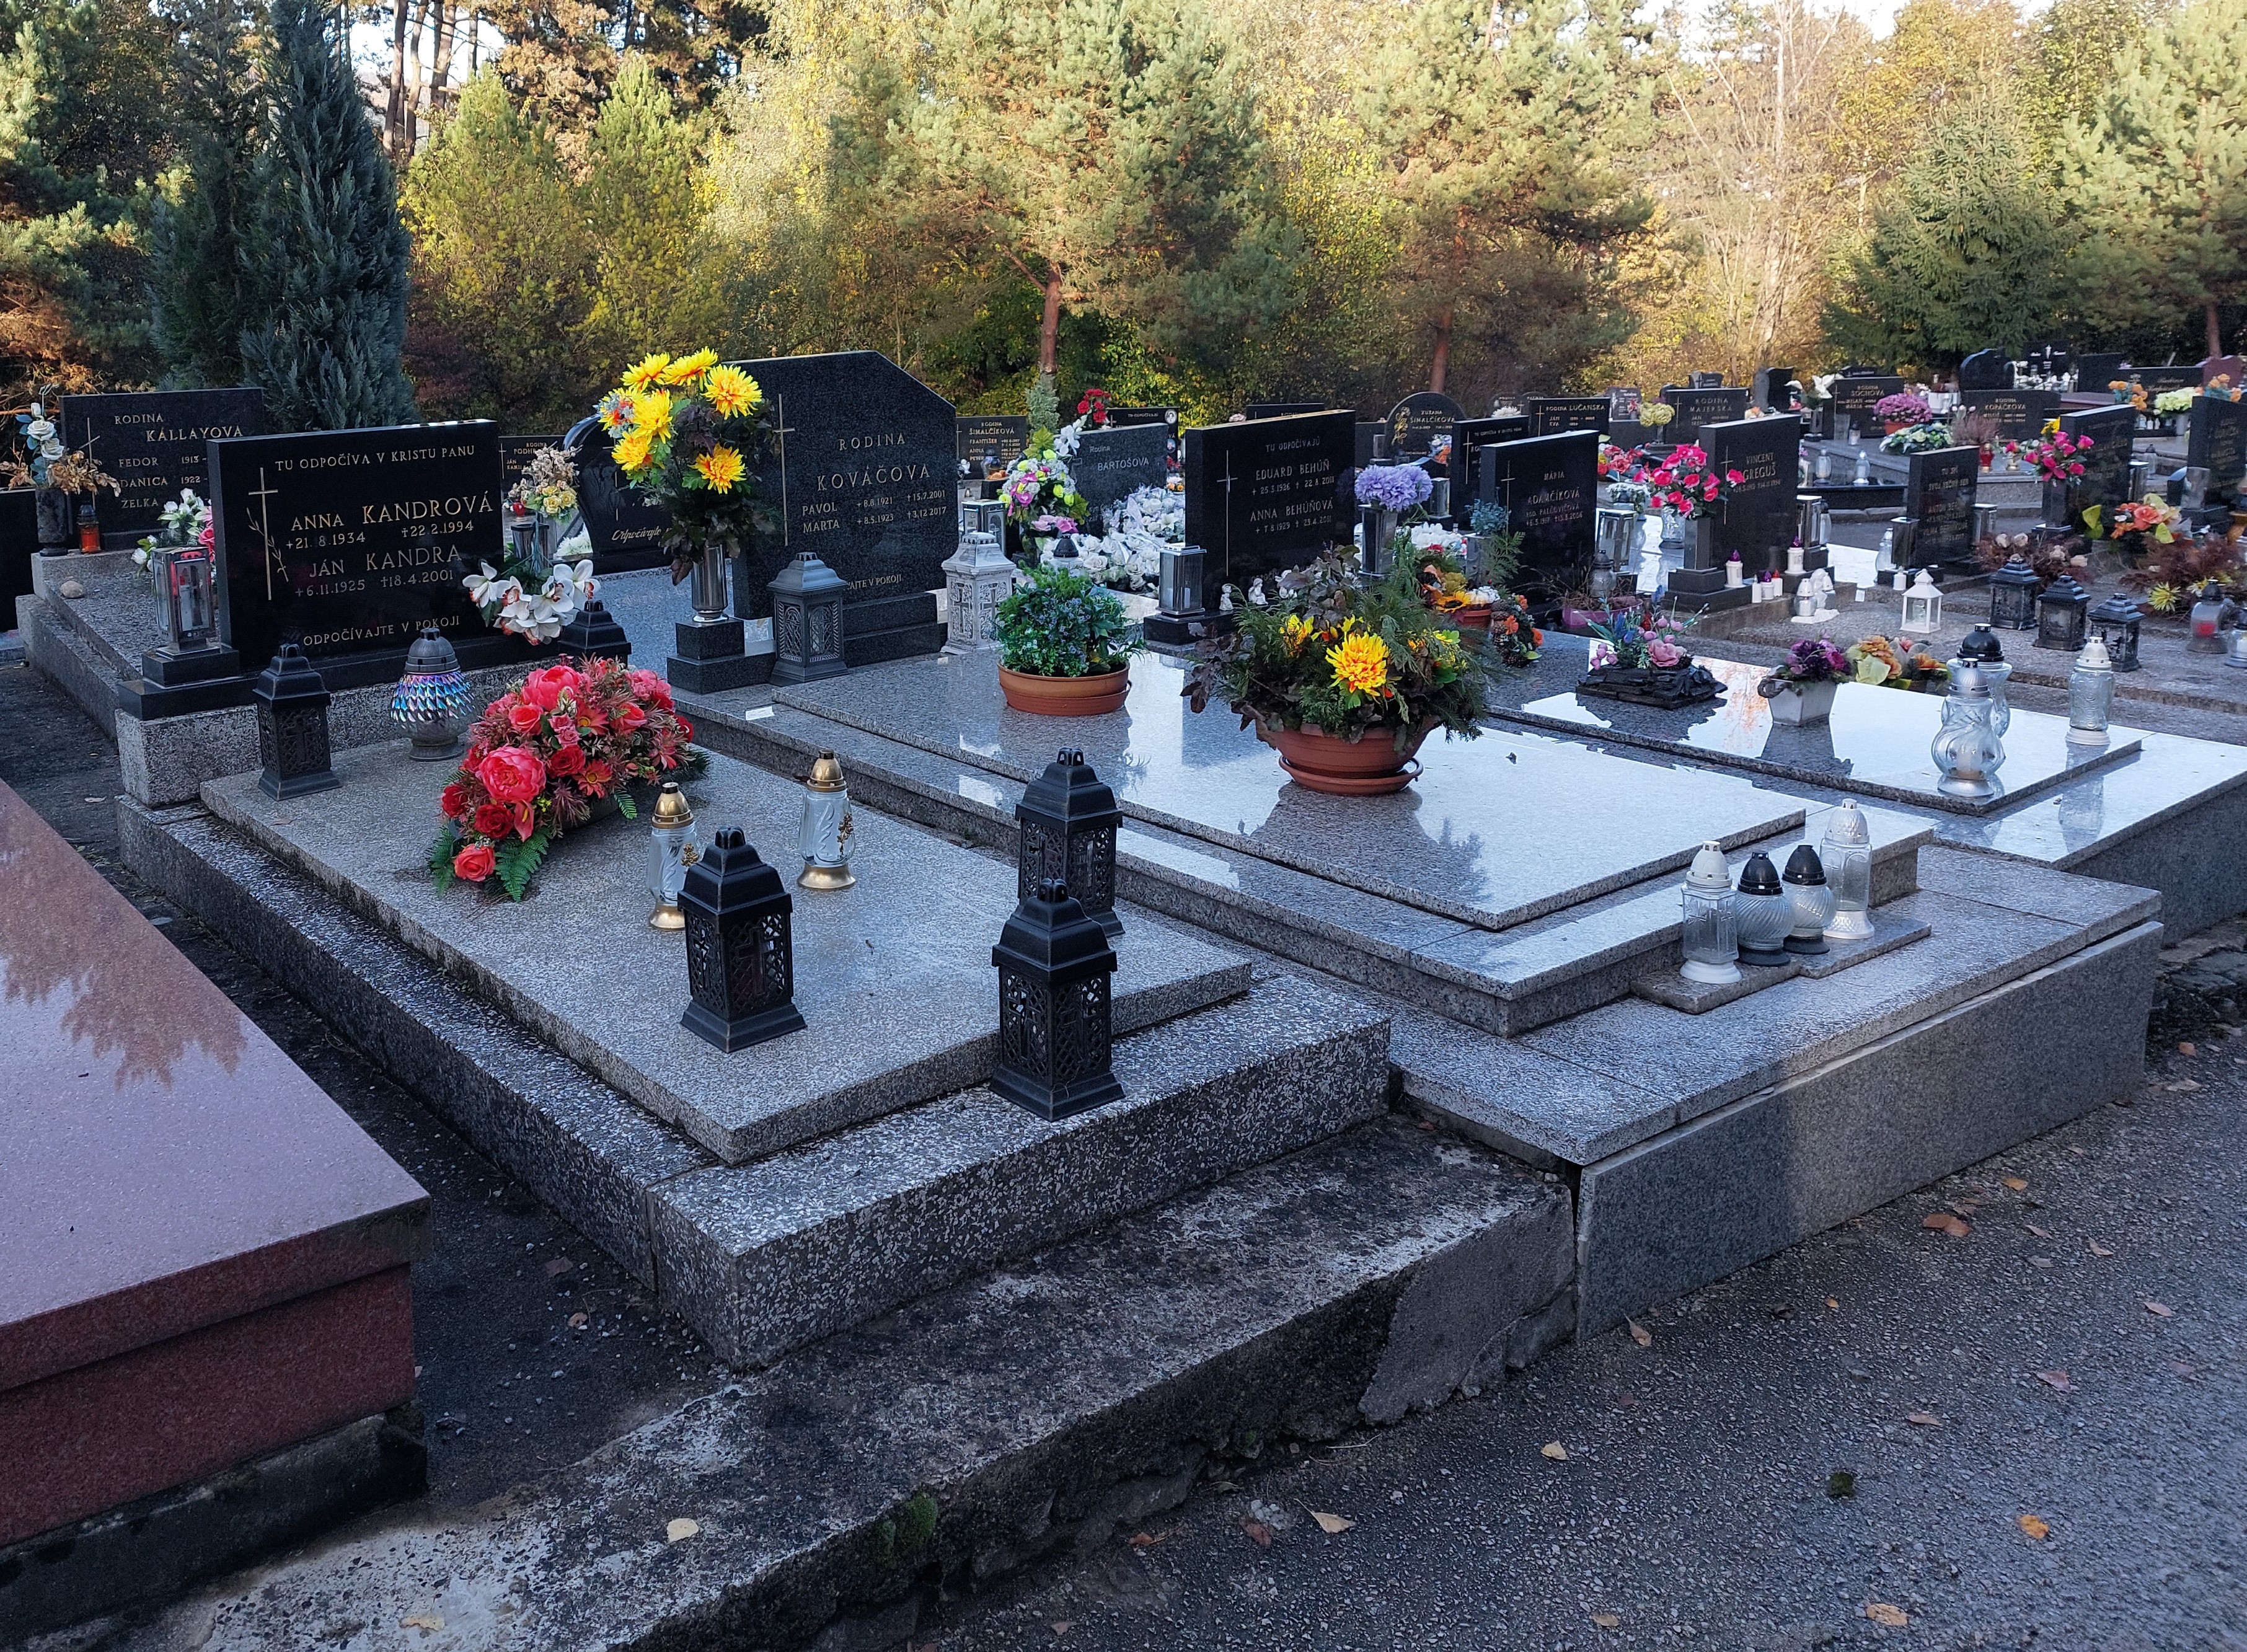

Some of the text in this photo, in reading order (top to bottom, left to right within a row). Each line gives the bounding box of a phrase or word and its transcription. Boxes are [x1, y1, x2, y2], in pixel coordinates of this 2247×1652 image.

[115, 413, 164, 425] RODINA
[839, 433, 906, 451] RODINA
[1266, 443, 1275, 452] TU
[118, 457, 159, 468] FEDOR
[275, 460, 293, 471] TU
[299, 453, 370, 469] ODPOČÍVA
[376, 452, 385, 464] V
[391, 448, 436, 462] KRISTU
[1098, 457, 1149, 471] BARTOŠOVA
[817, 463, 930, 492] KOVÁČOVA
[1256, 466, 1292, 480] EDUARD
[1743, 461, 1777, 481] GREGUŠ
[120, 476, 200, 488] DANICA 1922
[362, 490, 493, 524] KANDROVÁ
[802, 501, 837, 516] PAVOL
[291, 513, 345, 531] ANNA
[1250, 508, 1278, 522] ANNA
[803, 519, 841, 533] MARTA
[309, 544, 462, 577] JÁN KANDRA
[302, 616, 460, 646] ODPOČÍVAJTE V POKOJI
